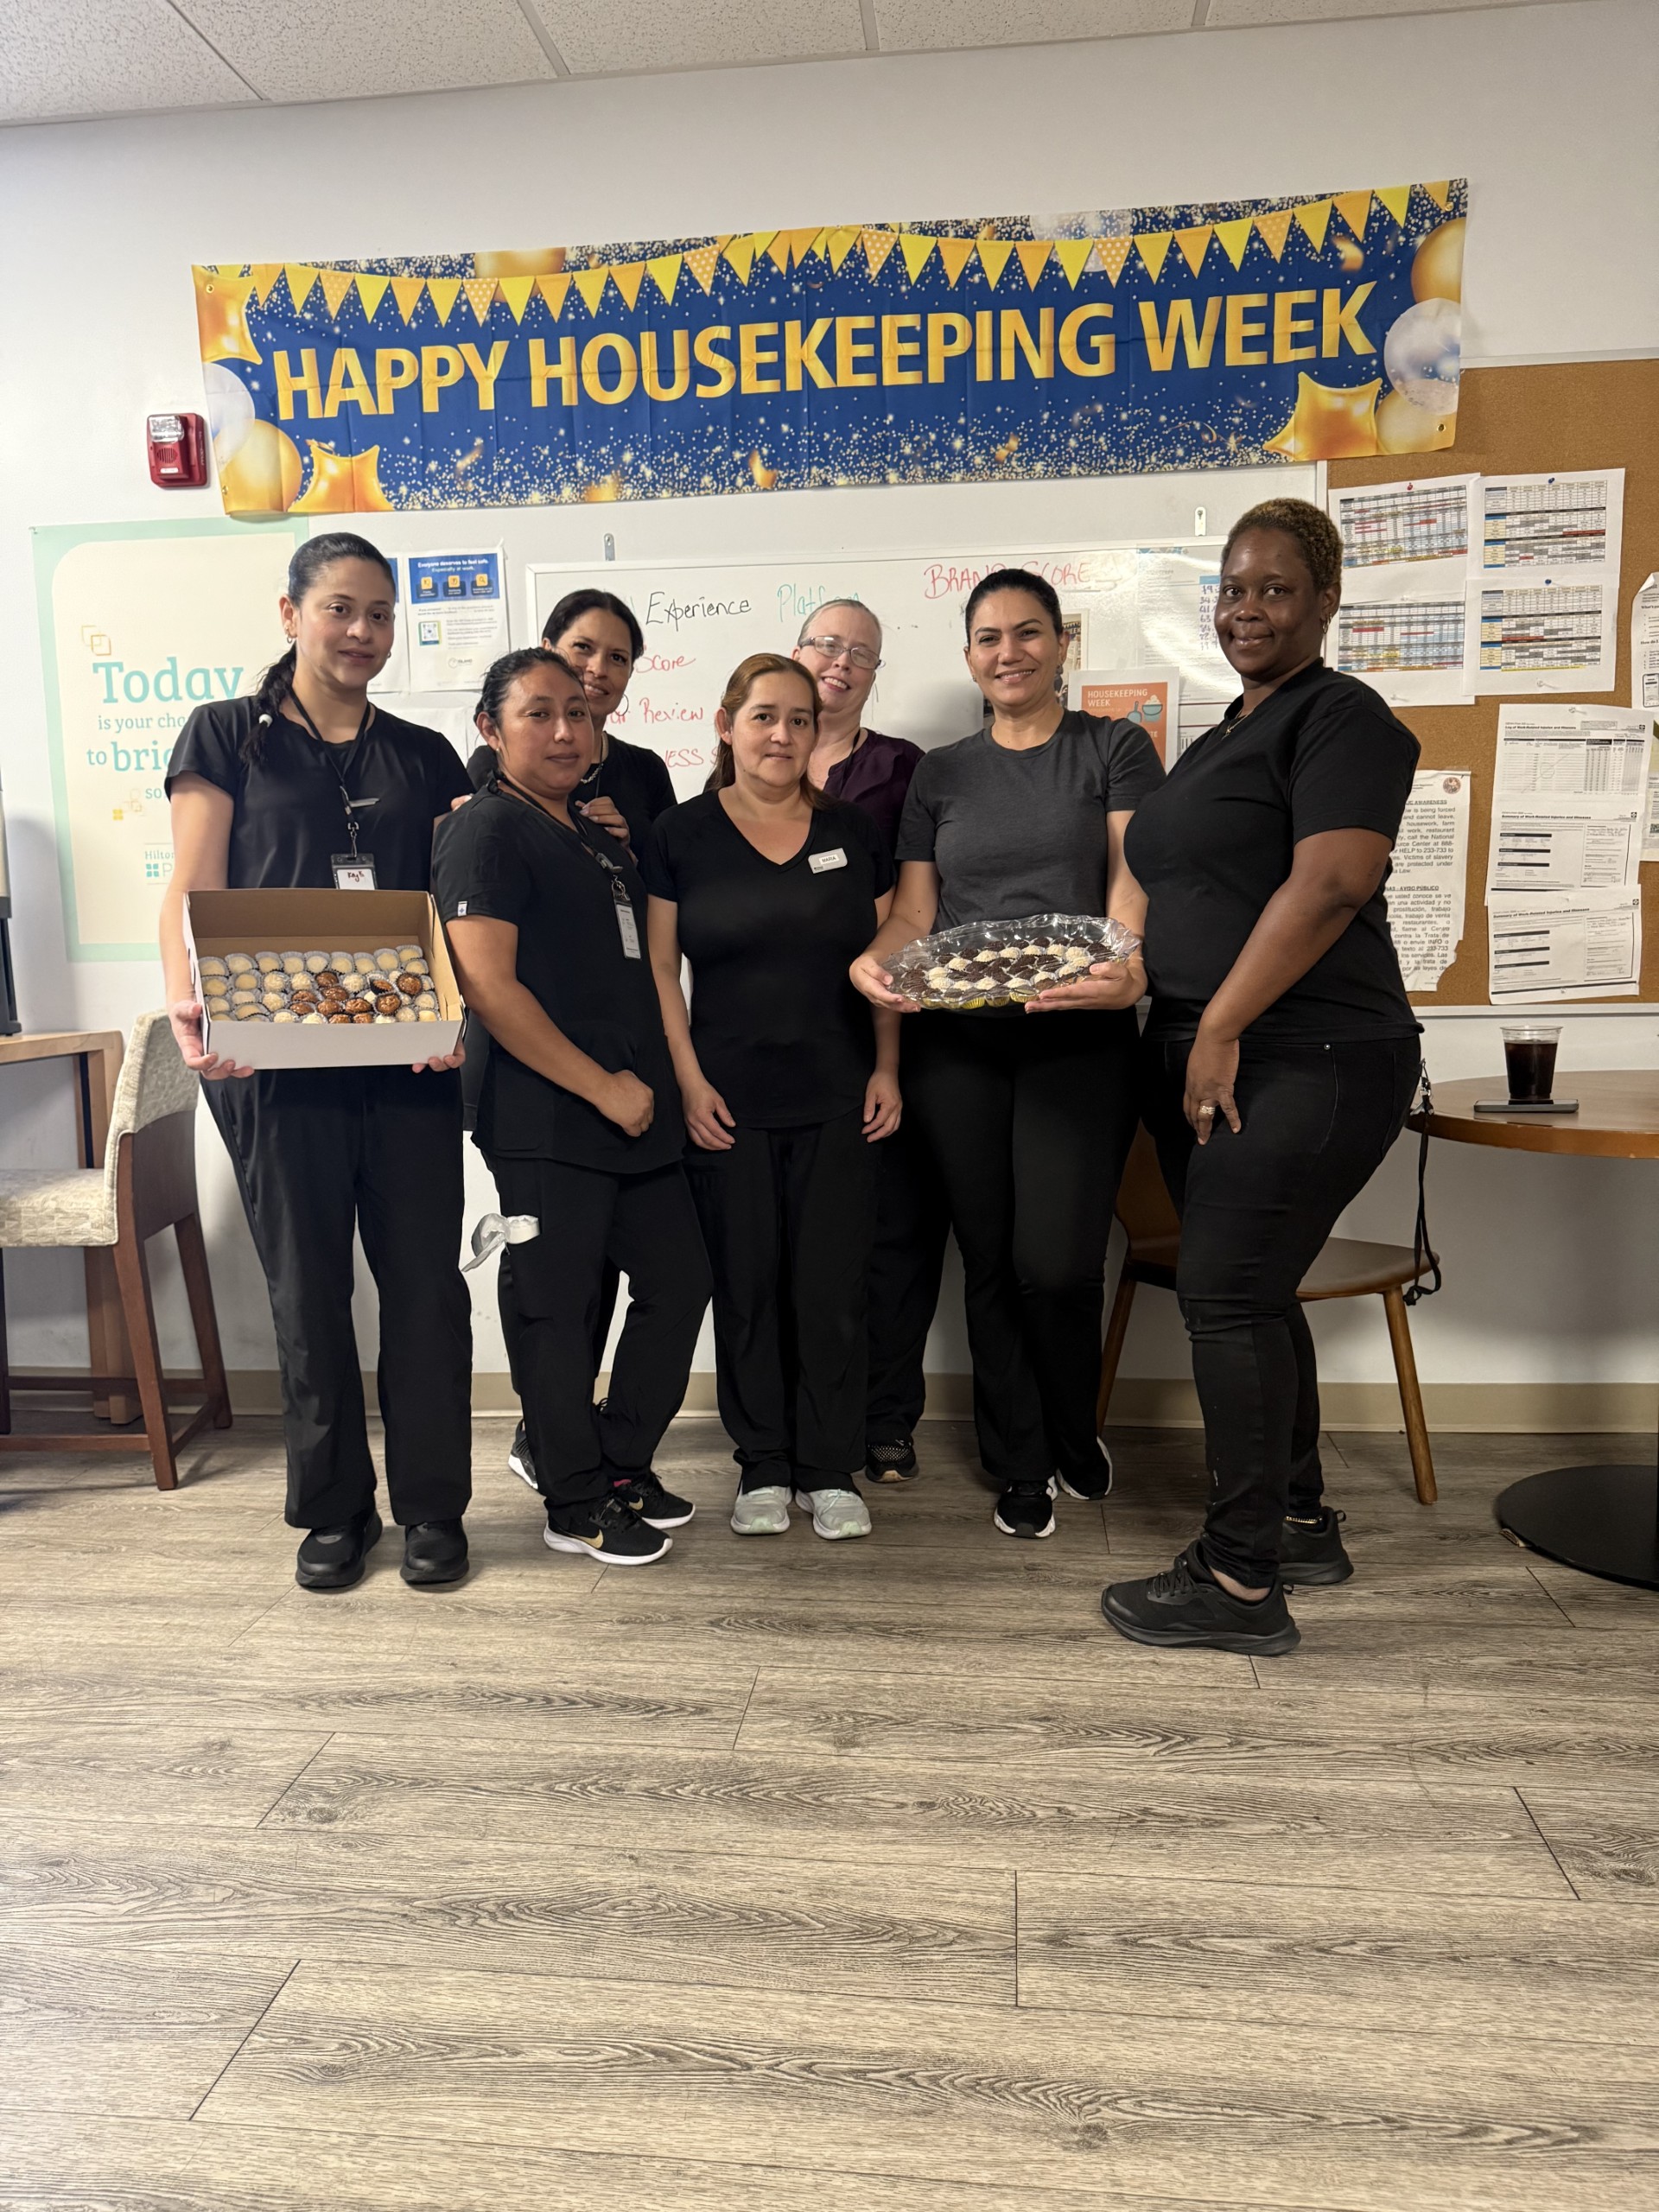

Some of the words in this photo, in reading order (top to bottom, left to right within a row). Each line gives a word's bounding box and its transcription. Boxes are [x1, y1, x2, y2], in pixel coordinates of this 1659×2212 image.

[273, 340, 510, 420] HAPPY
[528, 302, 1116, 408] HOUSEKEEPING
[1138, 281, 1378, 372] WEEK
[646, 591, 752, 632] Experience
[92, 657, 244, 703] Today
[1088, 689, 1147, 699] HOUSEKEEPING
[639, 697, 703, 724] Review
[99, 715, 111, 730] is
[116, 716, 153, 734] your
[86, 748, 107, 765] to
